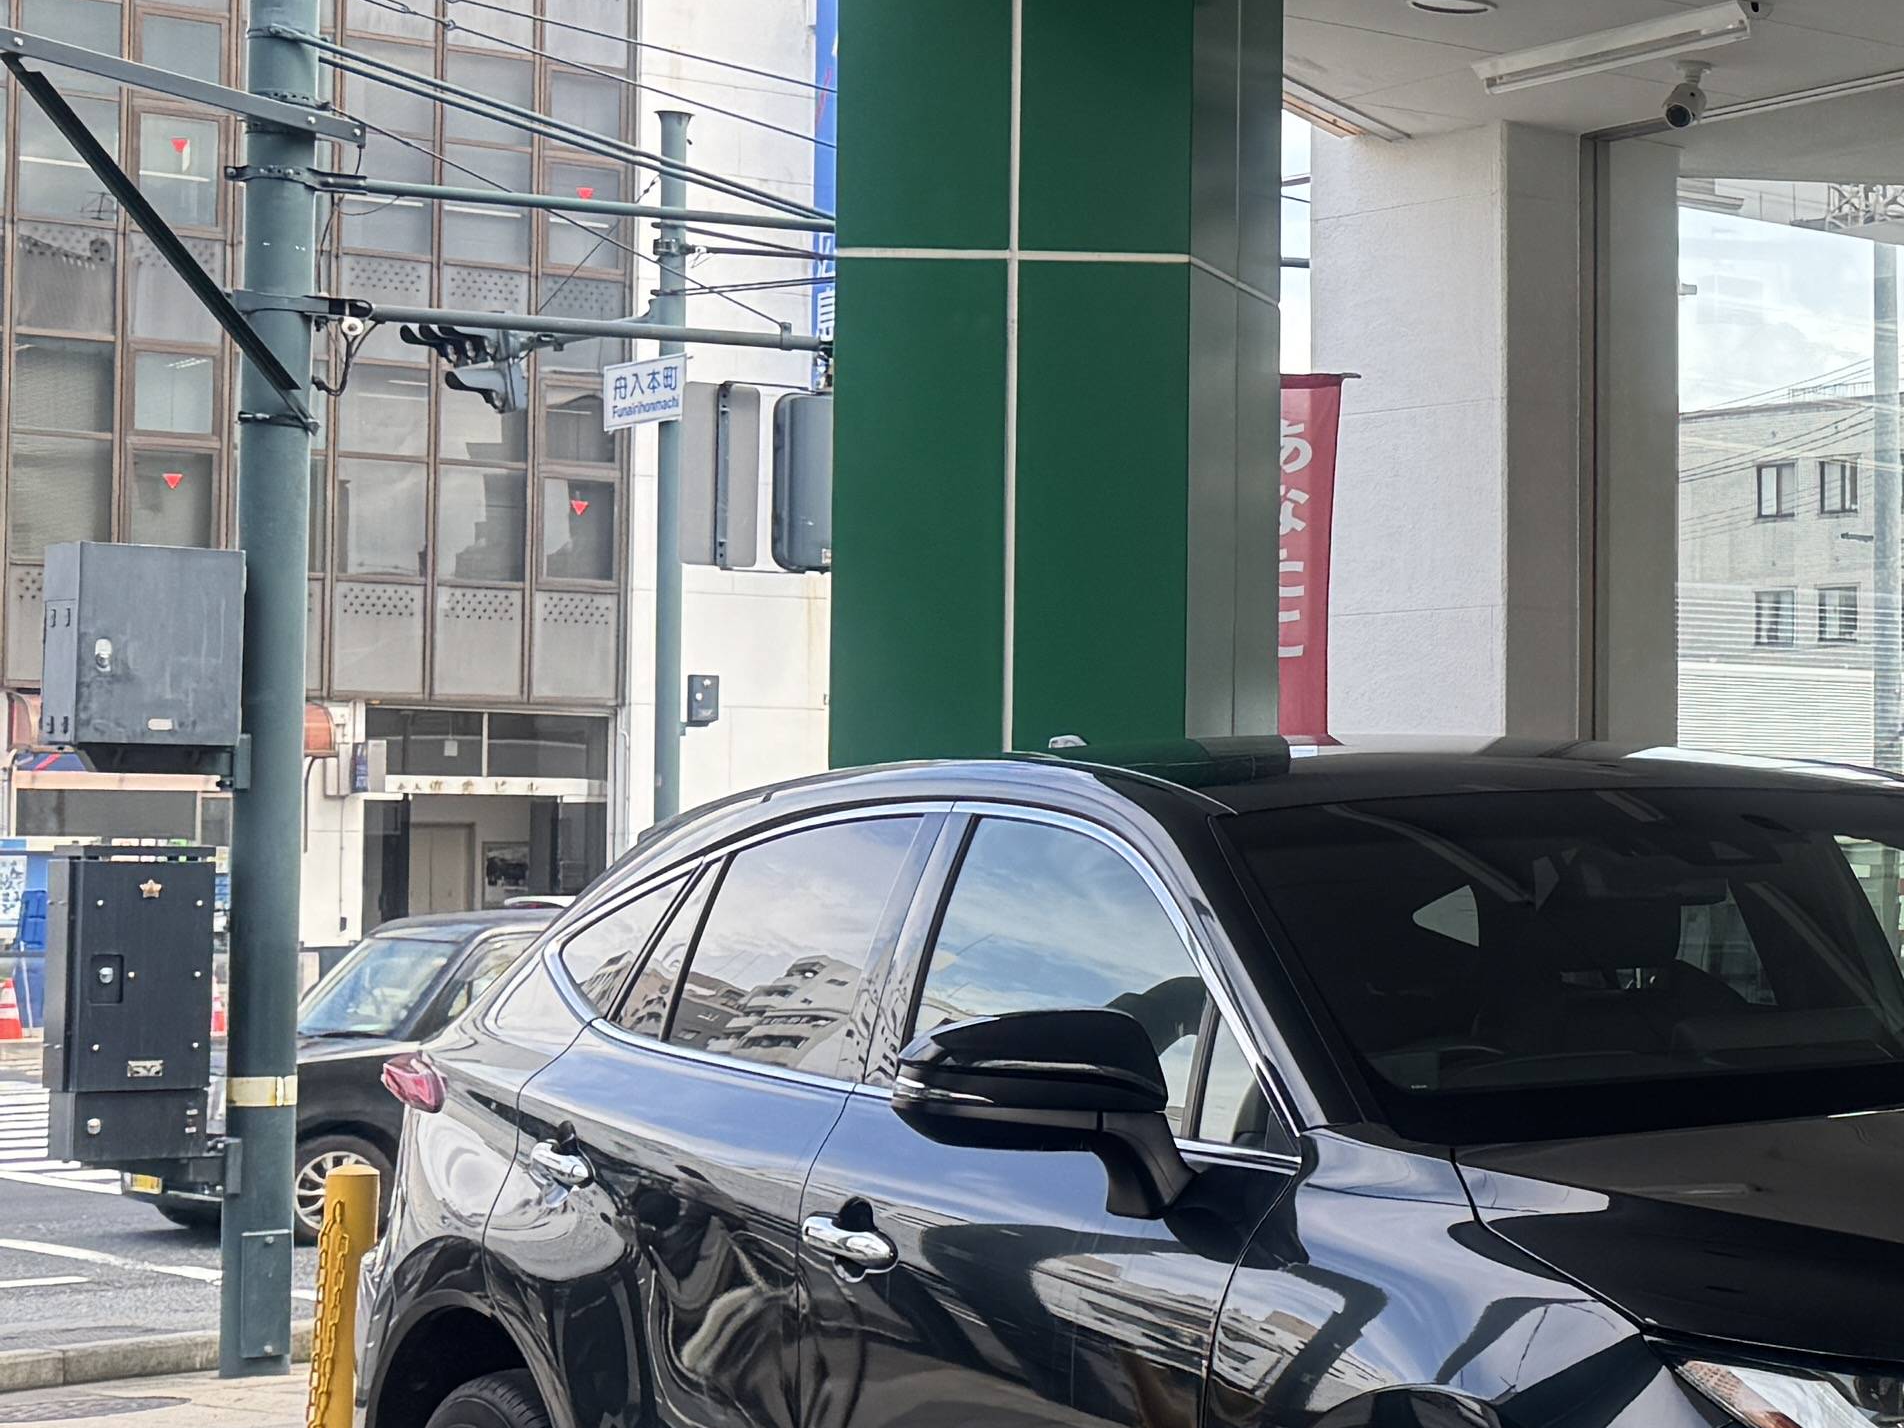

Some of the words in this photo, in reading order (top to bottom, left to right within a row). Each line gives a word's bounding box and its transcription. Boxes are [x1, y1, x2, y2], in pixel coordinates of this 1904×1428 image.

[613, 365, 678, 401] 舟入本町
[612, 394, 680, 419] Funairihonmachi
